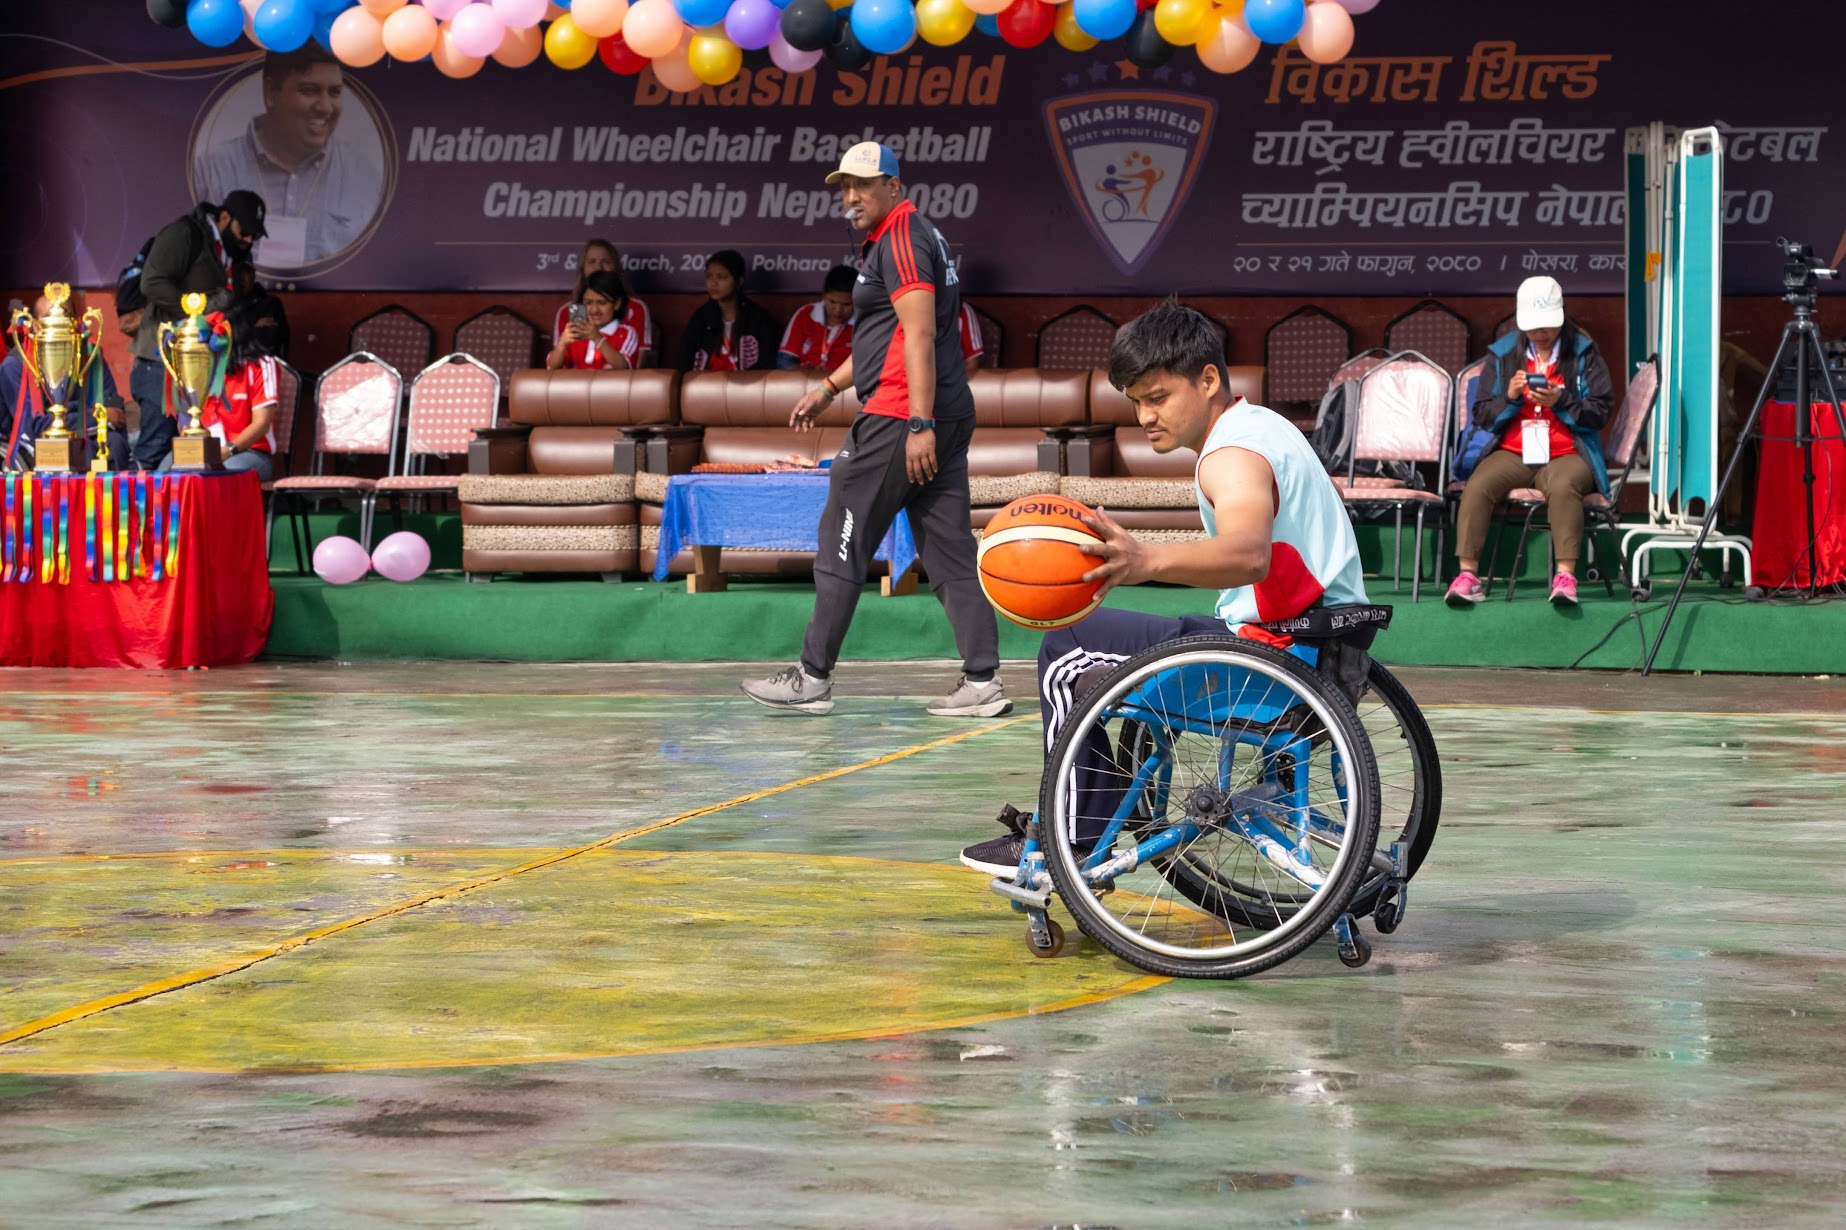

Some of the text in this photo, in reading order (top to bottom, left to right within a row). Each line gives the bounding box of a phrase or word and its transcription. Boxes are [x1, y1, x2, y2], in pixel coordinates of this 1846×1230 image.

[634, 54, 1006, 106] Bash Shield
[1264, 40, 1612, 104] विकास शिल्ड
[1058, 105, 1201, 135] BIKASH SHIELD
[1066, 128, 1188, 146] SPORT WITHOUT LIMITS
[407, 126, 563, 162] National
[573, 126, 781, 162] Wheelchair
[1251, 120, 1394, 176] राष्ट्रिय
[1400, 118, 1616, 168] ह्वीलचियर
[483, 182, 979, 226] Championship Nepa 080
[1241, 181, 1530, 228] च्याम्पियनसिप
[536, 253, 560, 270] 3rd
[564, 254, 577, 270] &
[1233, 256, 1261, 272] २०
[1268, 256, 1282, 271] र
[1288, 256, 1313, 272] २१
[1318, 250, 1352, 272] गते
[1427, 255, 1482, 272] २०८०
[1010, 502, 1083, 521] molten
